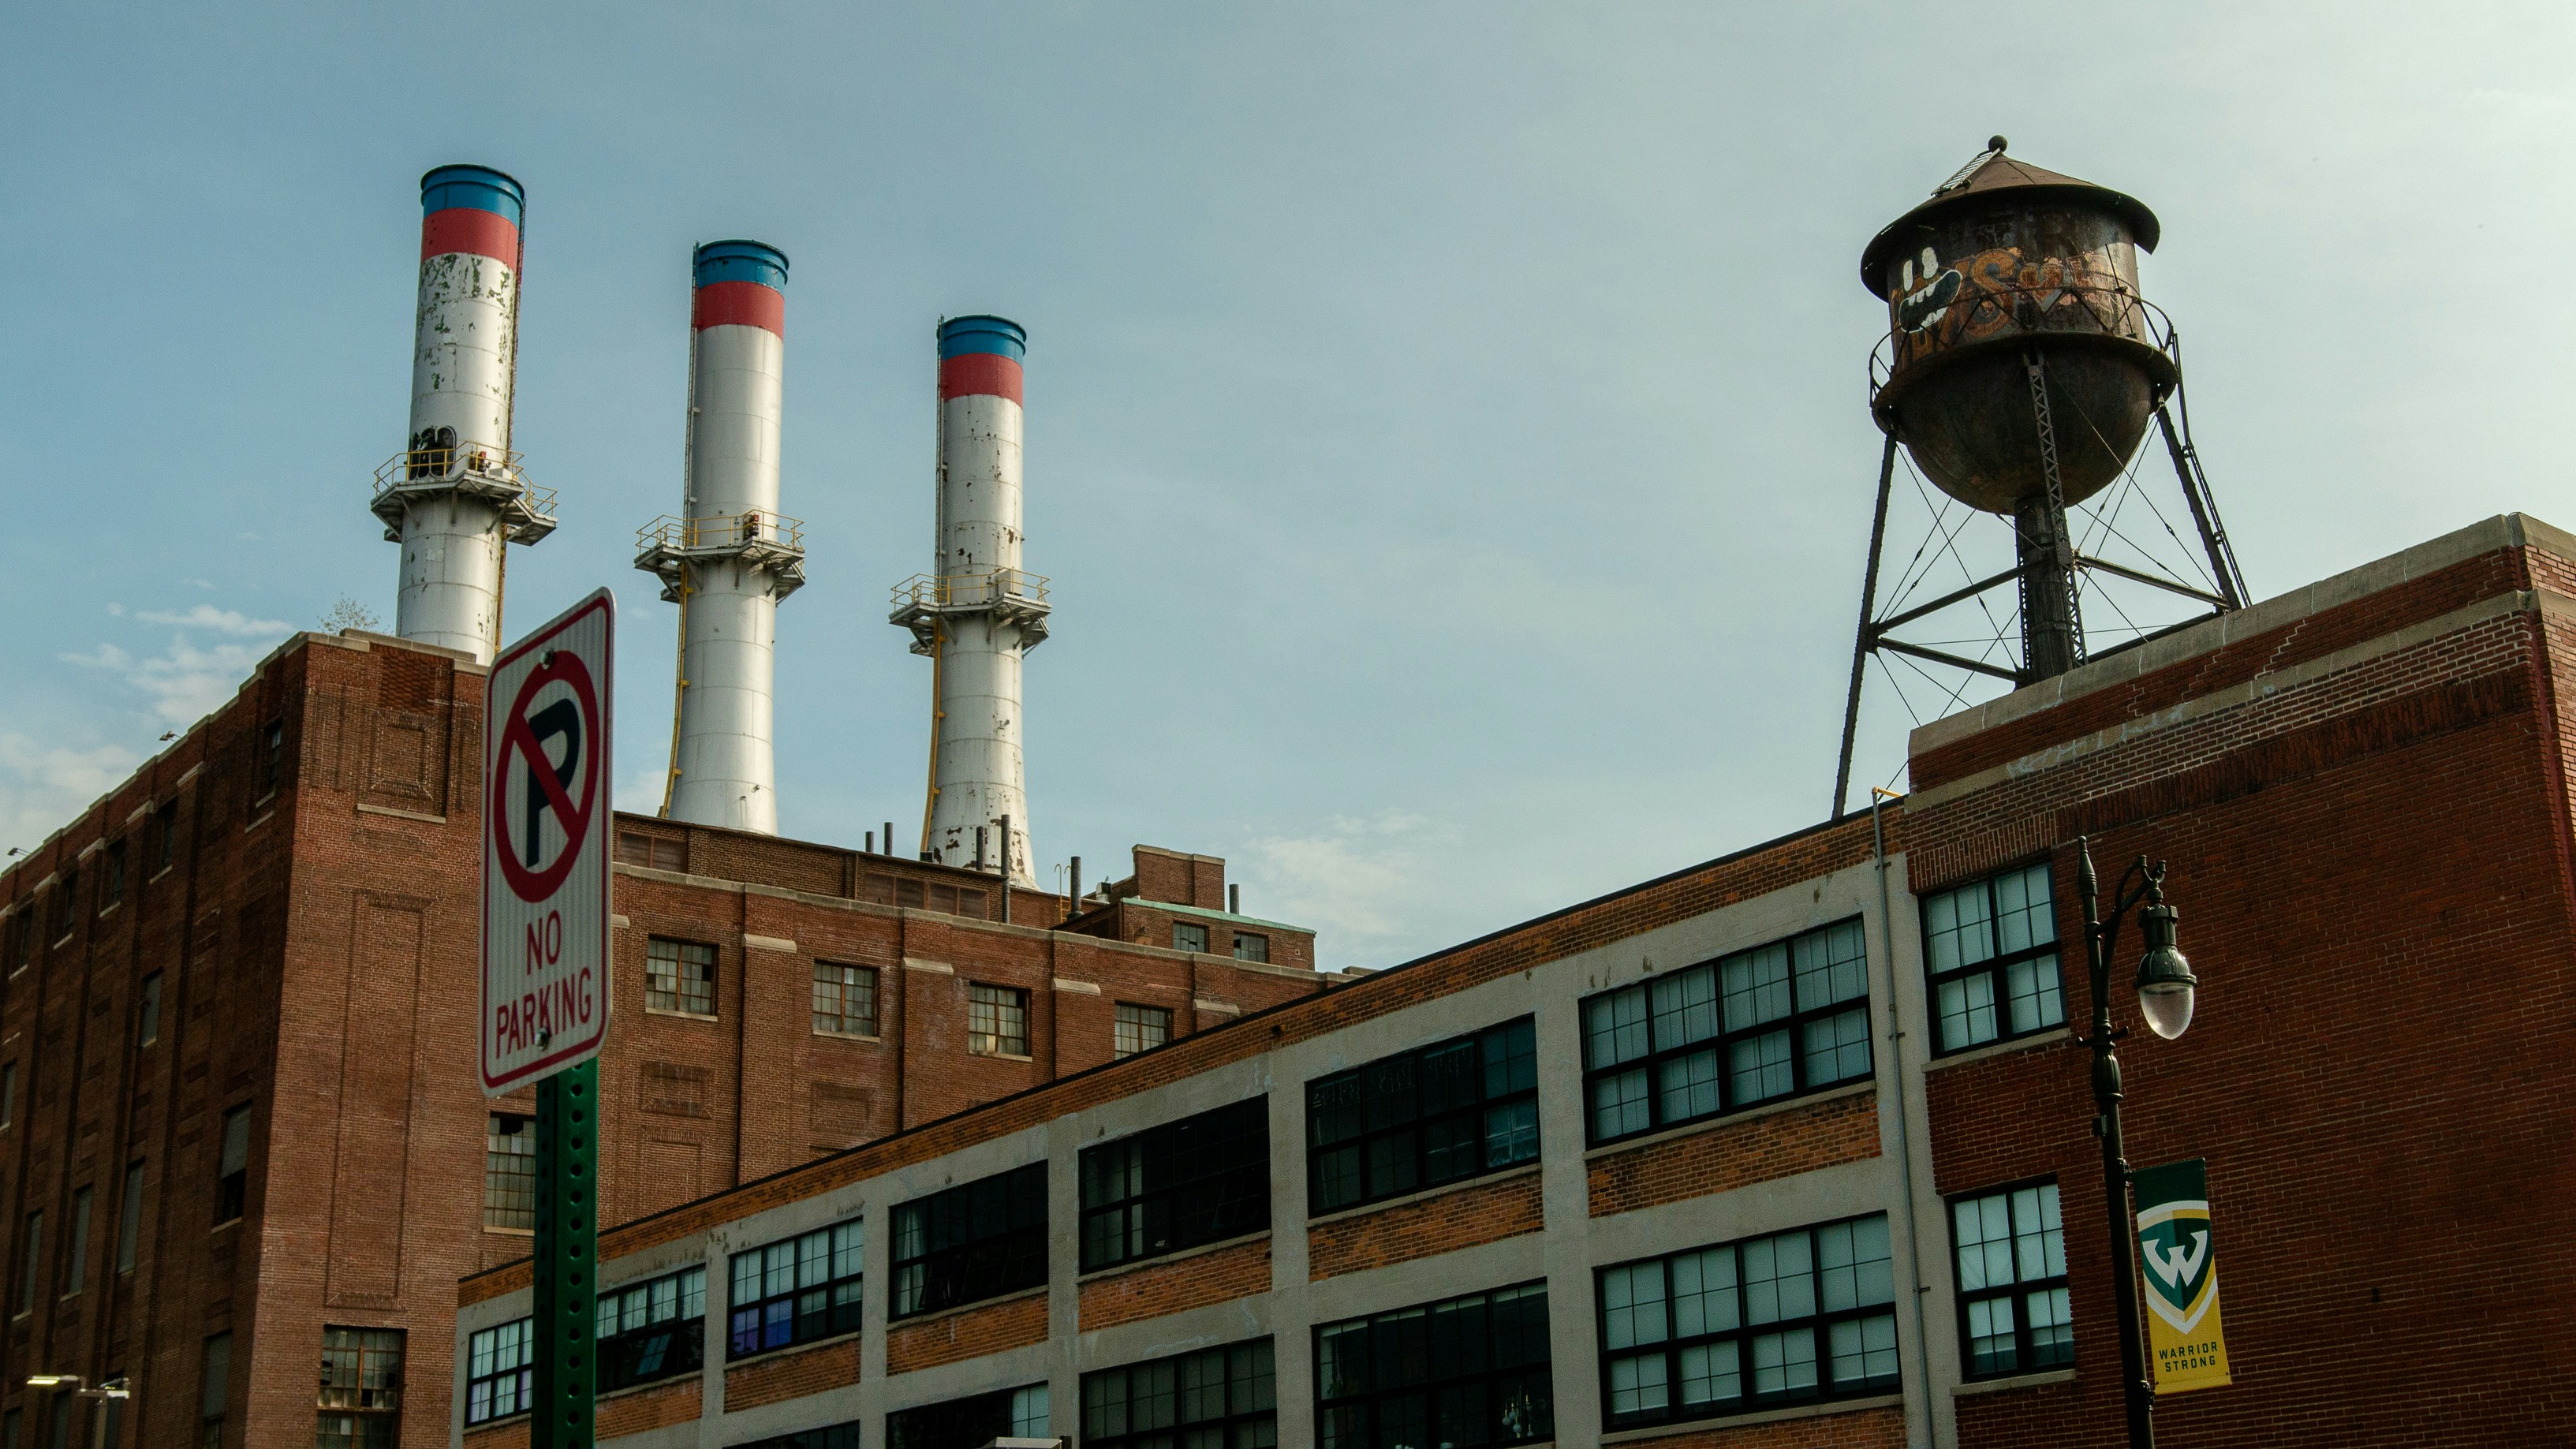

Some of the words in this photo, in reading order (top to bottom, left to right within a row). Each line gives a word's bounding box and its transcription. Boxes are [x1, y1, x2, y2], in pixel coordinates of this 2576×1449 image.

[527, 909, 562, 976] NO
[496, 967, 591, 1060] PARKING
[2159, 1342, 2218, 1360] WARRIOR
[2165, 1355, 2216, 1372] STRONG
